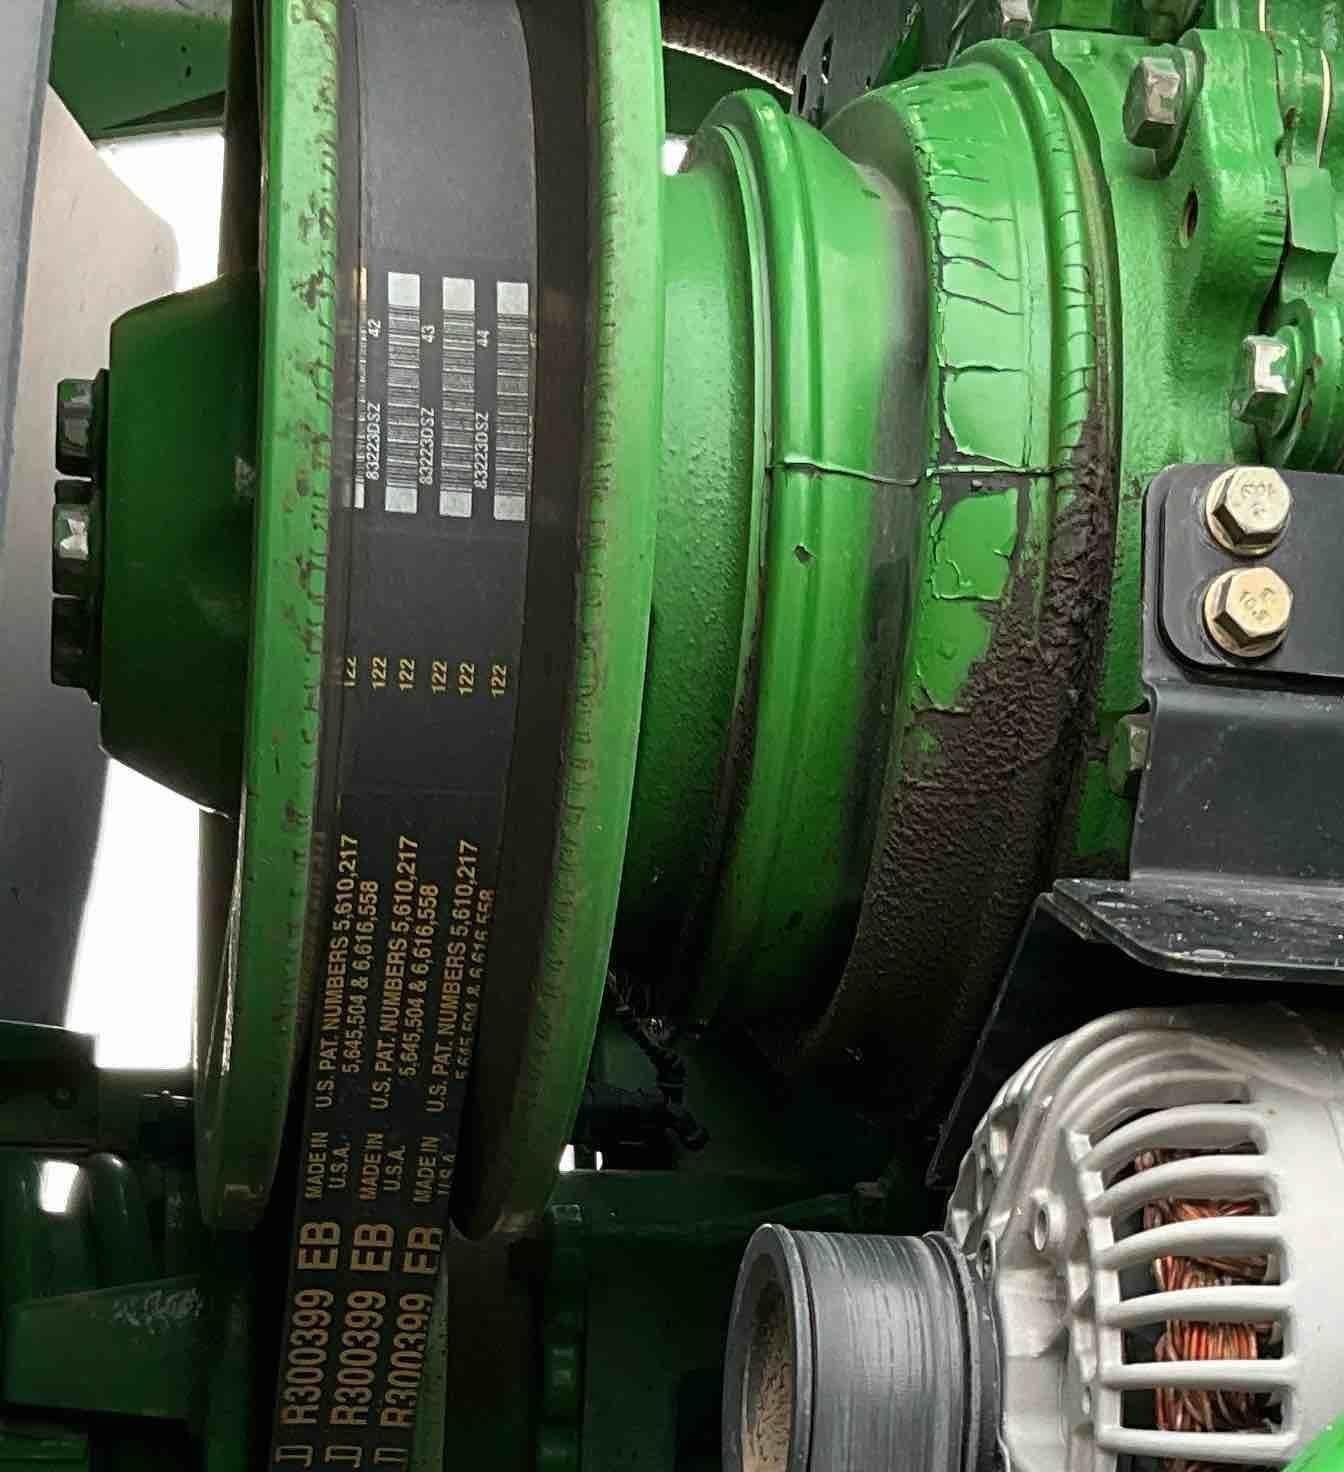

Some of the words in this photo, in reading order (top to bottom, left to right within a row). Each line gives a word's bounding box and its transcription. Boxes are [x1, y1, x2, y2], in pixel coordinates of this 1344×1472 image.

[368, 319, 381, 337] 42
[422, 325, 435, 343] 43
[477, 330, 490, 348] 44
[366, 403, 381, 480] 83223DSZ
[420, 407, 435, 485] 83223DSZ
[474, 412, 489, 489] 83223DSZ
[372, 656, 387, 689] 122
[399, 658, 415, 691] 122
[431, 660, 448, 694] 122
[459, 662, 475, 696] 122
[491, 664, 507, 697] 122
[333, 835, 358, 931] 5,610,217
[388, 836, 417, 932] 5,610,217
[447, 840, 478, 937] 5,610,217
[353, 881, 378, 970] 6,616,558
[408, 885, 438, 974] 6,616,558
[322, 937, 349, 1029] NUMBERS
[351, 977, 369, 988] &
[378, 938, 408, 1032] NUMBERS
[407, 980, 426, 992] &
[437, 942, 466, 1035] NUMBERS
[320, 1036, 340, 1070] PAT.
[342, 995, 368, 1073] 5,645,504
[375, 1038, 395, 1072] PAT.
[398, 998, 425, 1076] 5,645,504
[432, 1044, 452, 1075] PAT.
[315, 1076, 336, 1107] U.S.
[370, 1078, 392, 1109] U.S.
[426, 1081, 447, 1112] U.S.
[311, 1132, 328, 1148] IN
[365, 1133, 383, 1149] IN
[420, 1137, 440, 1152] IN
[305, 1153, 327, 1199] MADE
[330, 1143, 351, 1188] U.S.A.
[359, 1153, 381, 1200] MADE
[384, 1145, 406, 1191] U.S.A.
[413, 1157, 436, 1202] MADE
[297, 1222, 341, 1269] EB
[350, 1223, 395, 1271] EB
[281, 1290, 334, 1424] R300399
[330, 1291, 386, 1425] R300399
[379, 1293, 433, 1427] R300399
